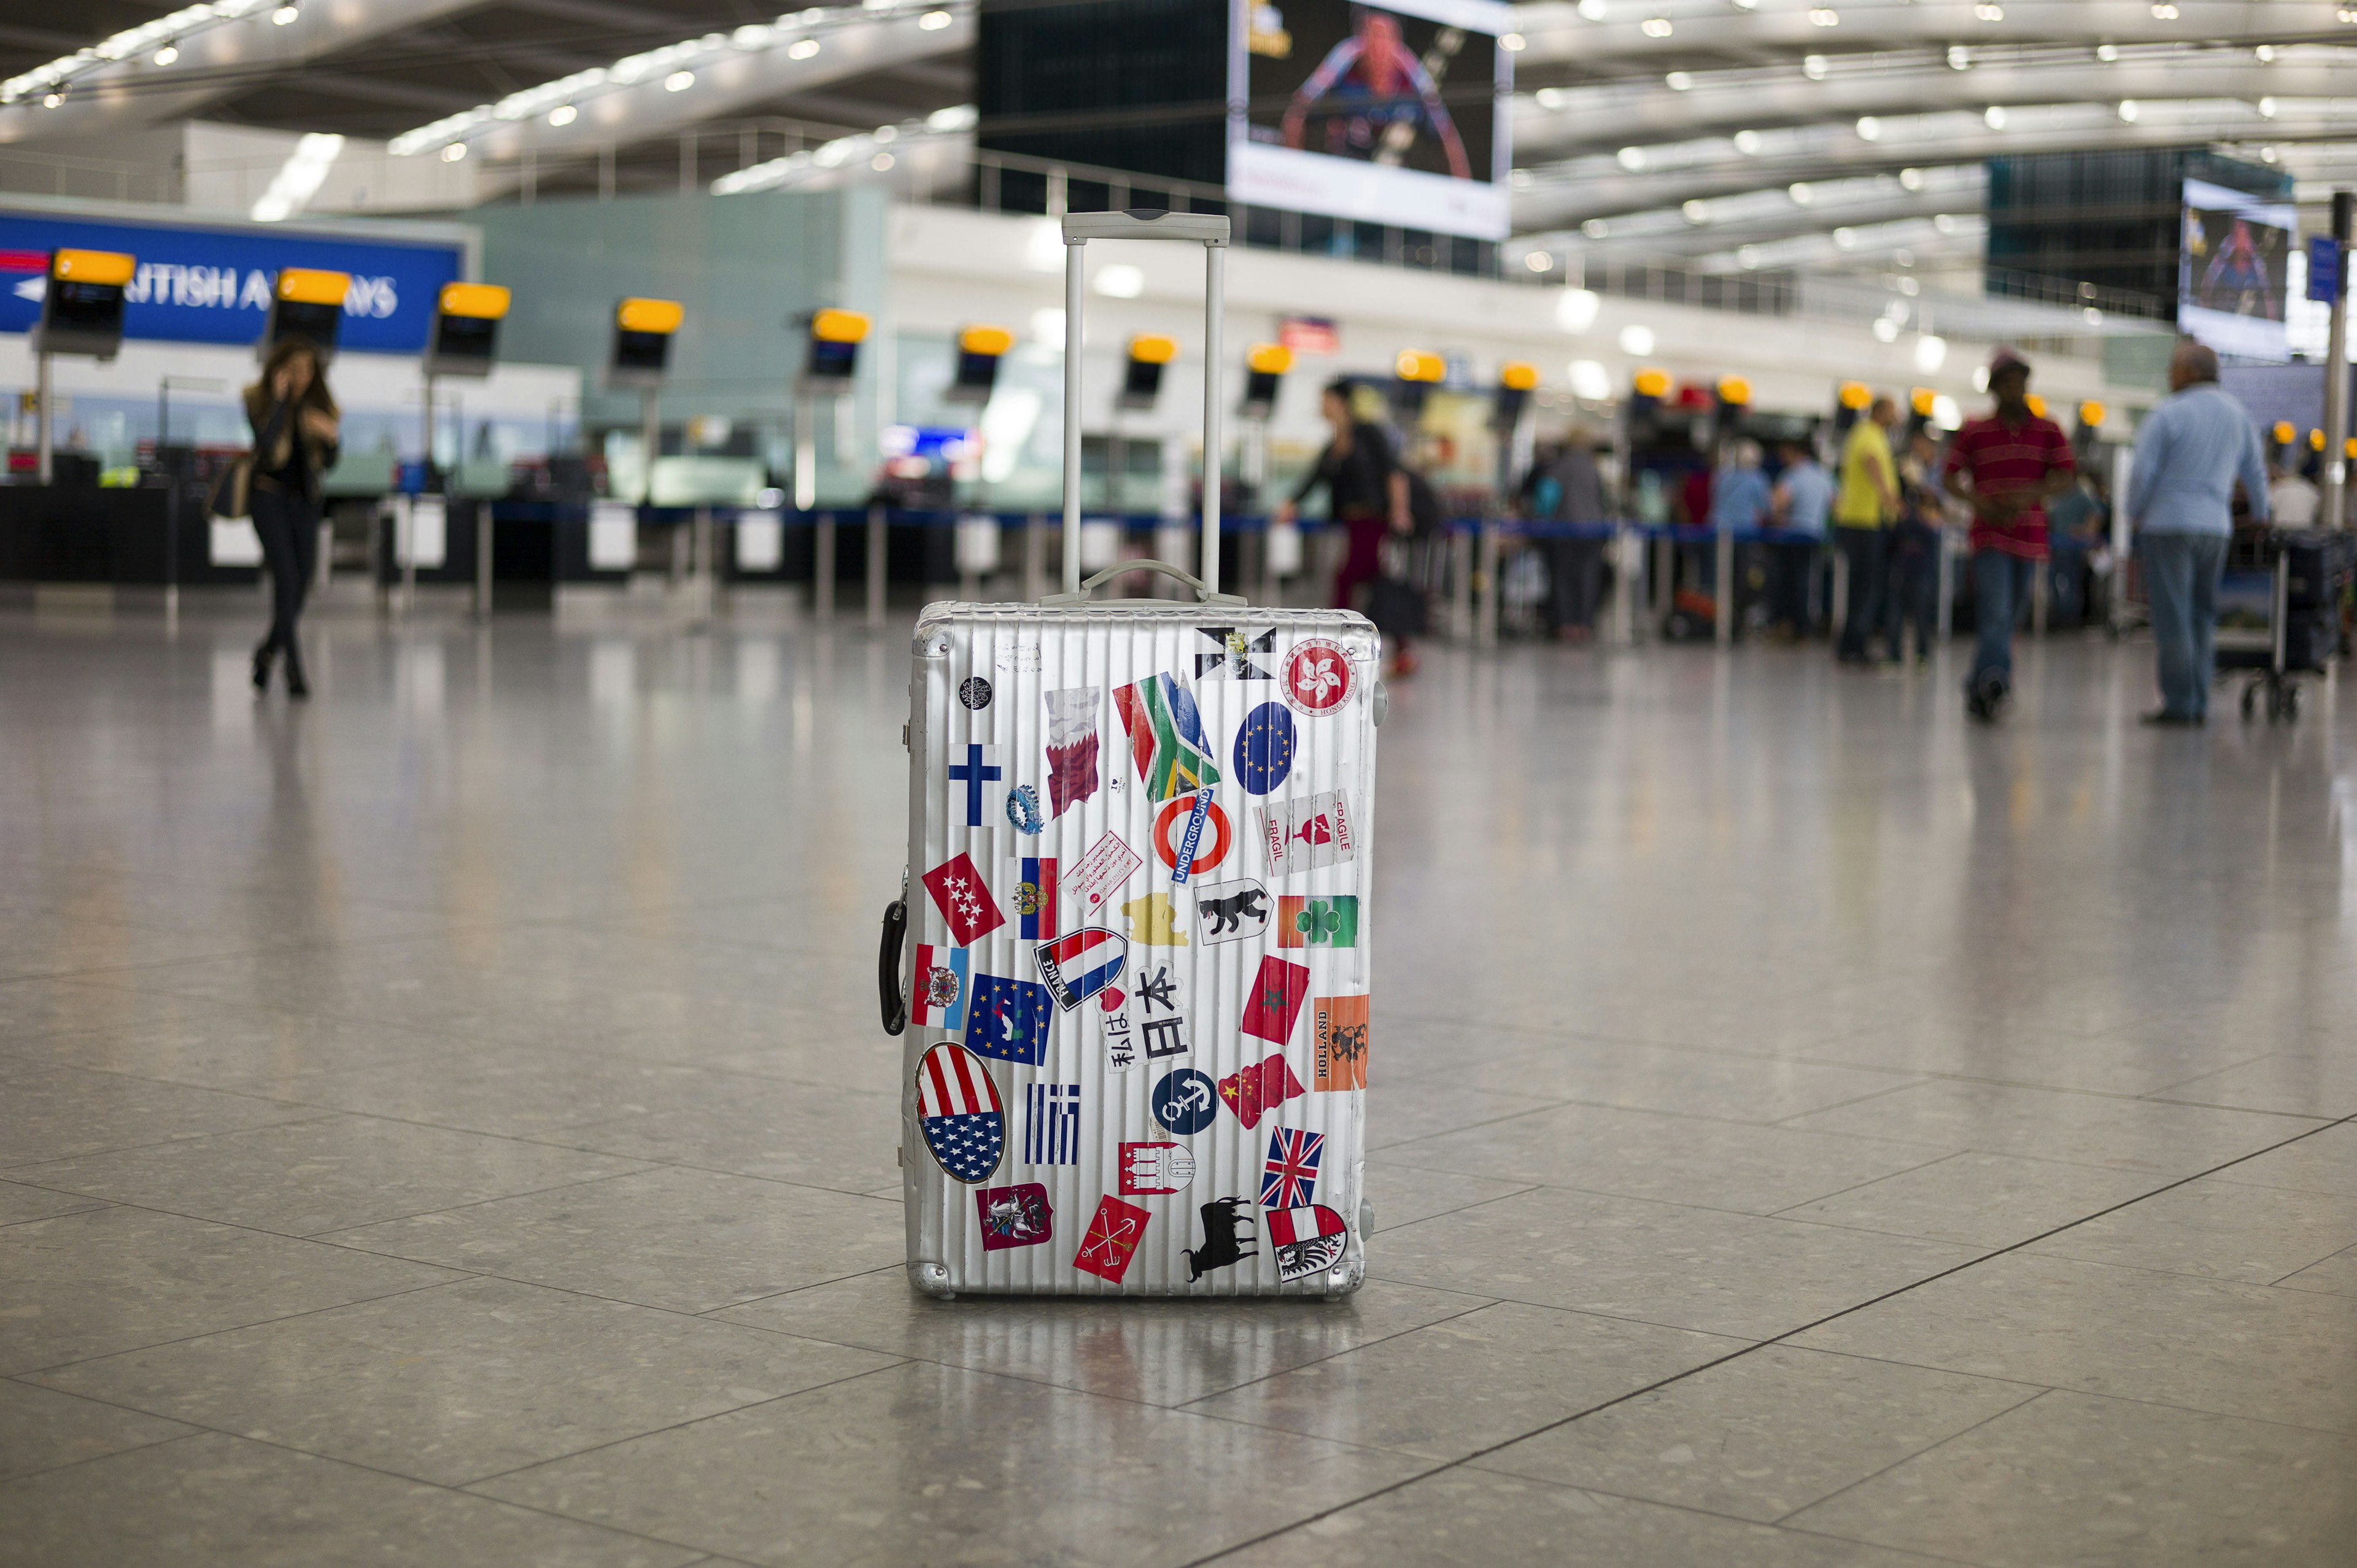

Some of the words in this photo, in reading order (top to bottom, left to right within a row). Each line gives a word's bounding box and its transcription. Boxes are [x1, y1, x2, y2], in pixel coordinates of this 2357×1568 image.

[124, 263, 237, 308] ITISH
[961, 690, 971, 706] LARS
[963, 682, 979, 708] BORGES
[976, 679, 988, 701] GRAPH
[1320, 703, 1342, 716] HONG
[1342, 682, 1355, 703] KONG
[1177, 789, 1210, 881] UNDERGROUND
[1269, 820, 1283, 862] FRAGIL
[1099, 879, 1113, 894] QATAR
[1112, 868, 1124, 881] DUTY
[1043, 959, 1069, 997] FRANCE
[1135, 966, 1188, 1059] 日本
[1105, 1013, 1135, 1067] 私は
[1318, 1011, 1328, 1078] HOLLAND
